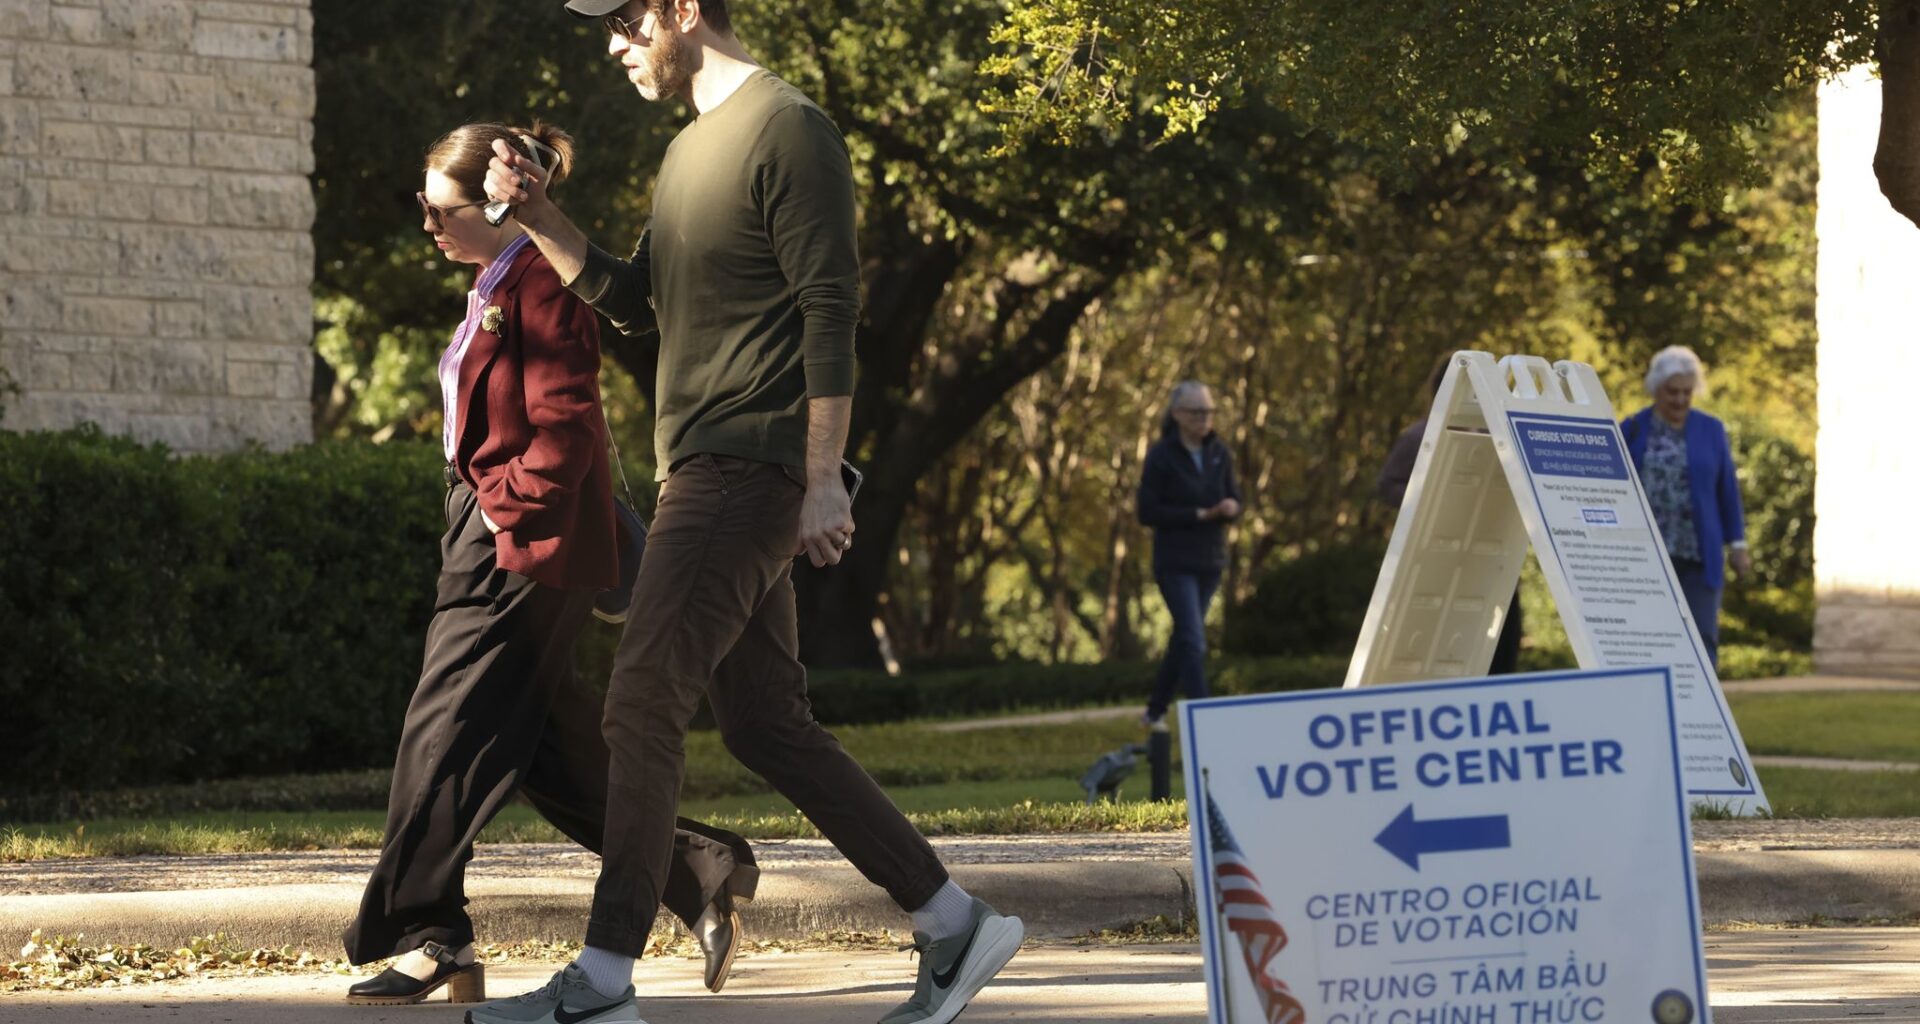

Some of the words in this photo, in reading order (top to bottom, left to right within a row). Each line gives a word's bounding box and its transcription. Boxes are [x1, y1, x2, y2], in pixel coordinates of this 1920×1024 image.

[1528, 430, 1561, 443] CURBSIDE
[1560, 432, 1586, 445] VOTING
[1585, 434, 1608, 447] SPACE
[1308, 699, 1550, 750] OFFICIAL
[1256, 757, 1398, 800] VOTE
[1415, 739, 1624, 788] CENTER
[1305, 886, 1449, 920] CENTRO
[1462, 877, 1601, 910] OFICIAL
[1334, 921, 1379, 948] DE
[1391, 907, 1577, 944] VOTACIÓN
[1318, 972, 1437, 1004] TRUNG
[1450, 962, 1524, 995] TÂM
[1388, 1001, 1496, 1024] CHÍNH
